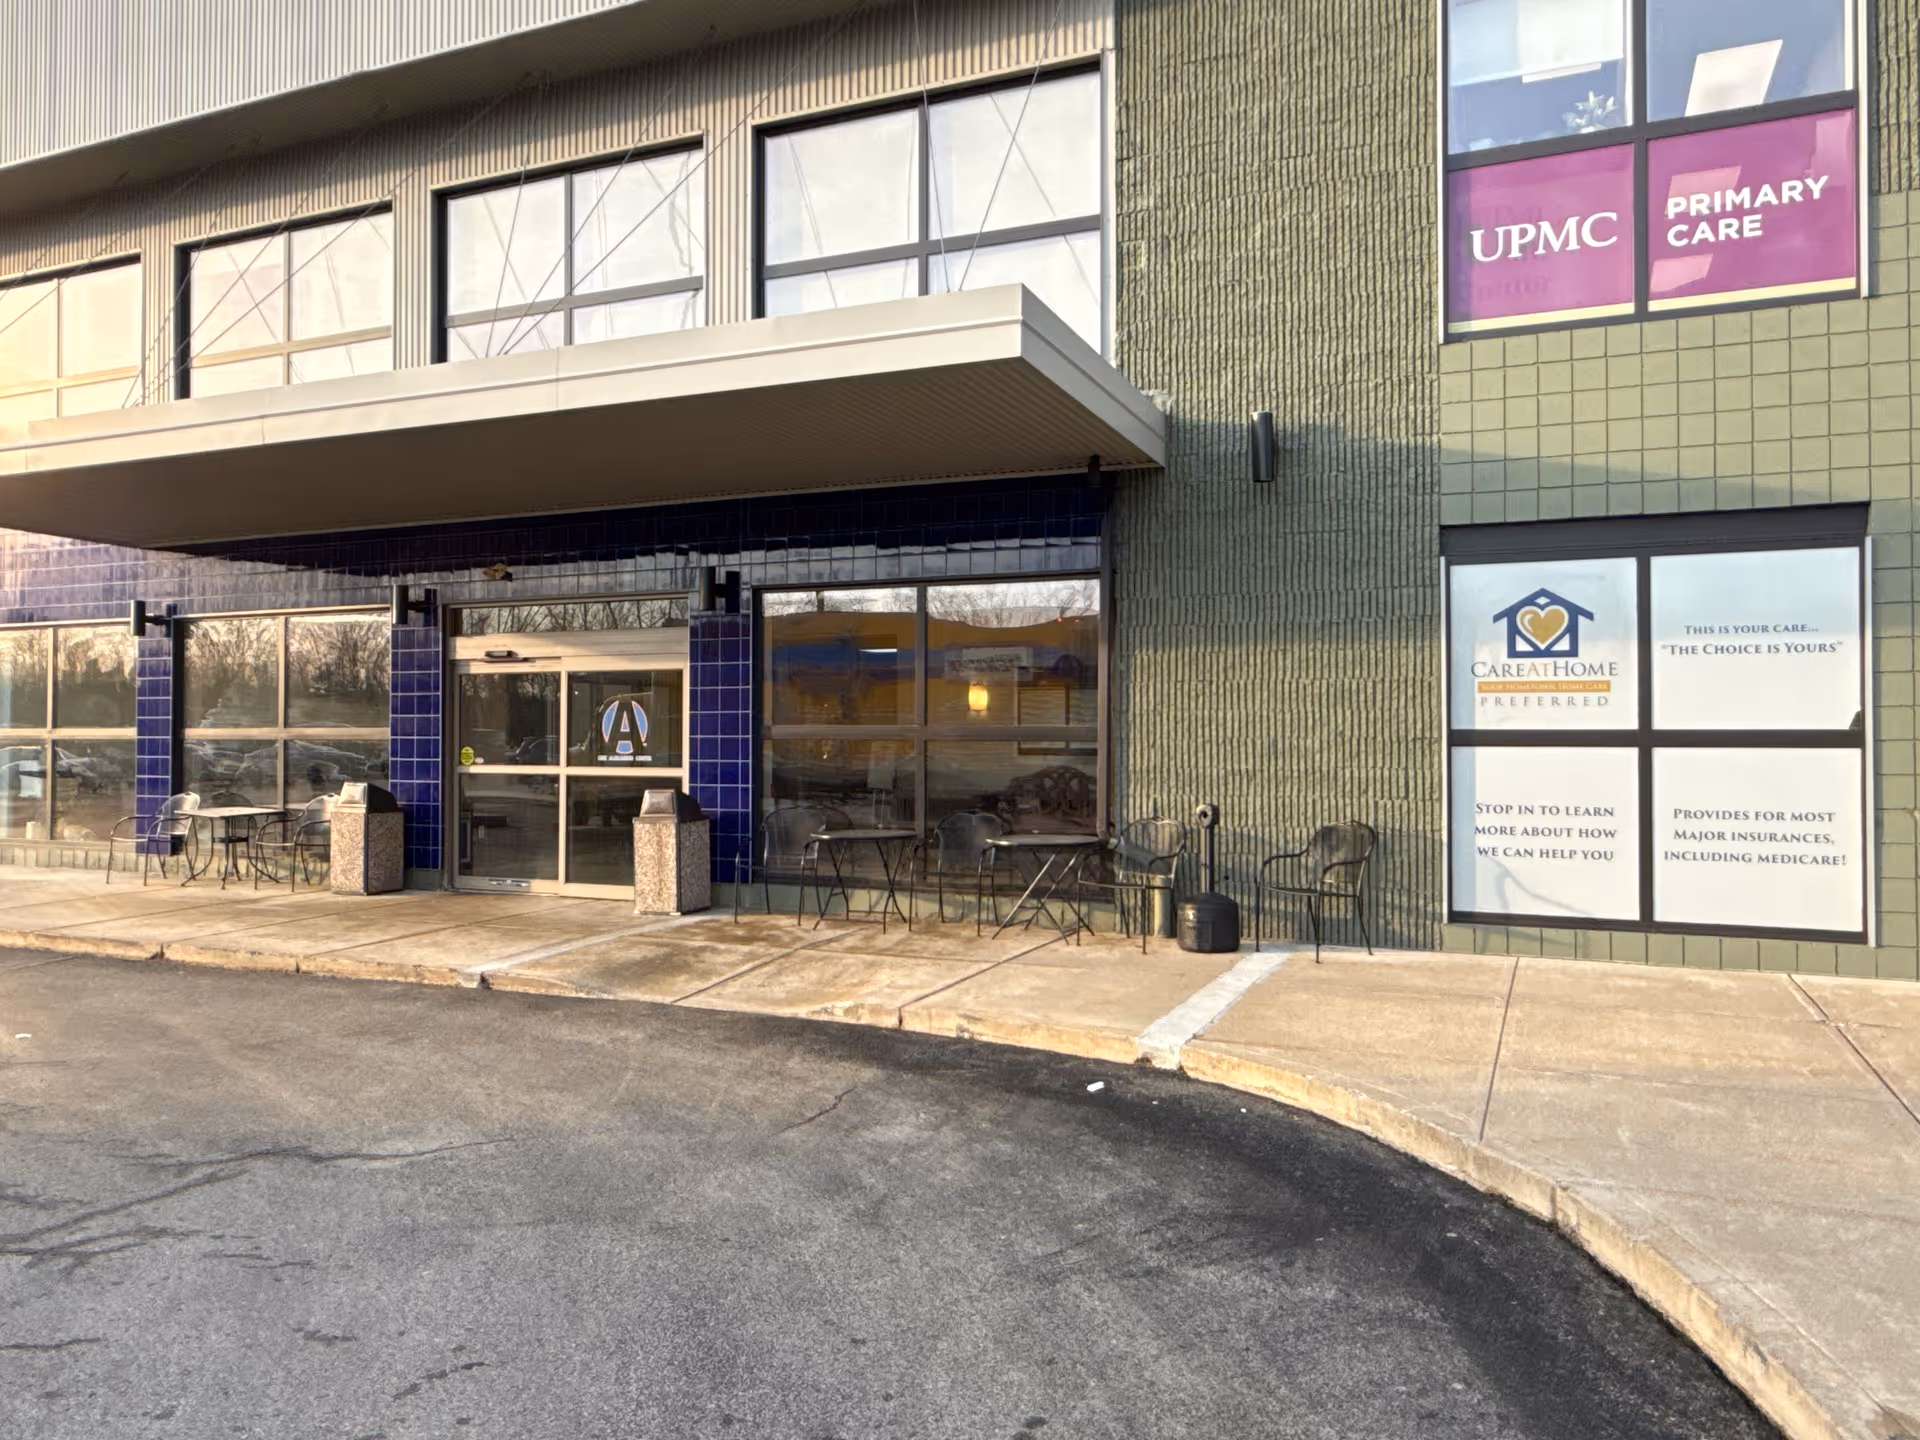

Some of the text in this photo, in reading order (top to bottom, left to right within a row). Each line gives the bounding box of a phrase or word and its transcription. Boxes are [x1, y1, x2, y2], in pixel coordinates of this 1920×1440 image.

[1666, 175, 1829, 219] PRIMARY
[1470, 212, 1618, 262] UPMC
[1667, 214, 1763, 247] CARE
[1684, 625, 1715, 635] THIS
[1718, 625, 1730, 634] IS
[1733, 624, 1769, 634] YOUR
[1702, 643, 1762, 655] CHOICE
[1767, 644, 1780, 654] IS
[1480, 695, 1609, 707] PREFERRED
[1476, 802, 1615, 817] STOP IN TO LEARN
[1673, 808, 1836, 823] PROVIDES FOR MOST
[1474, 825, 1617, 839] MORE ABOUT HOW
[1673, 829, 1836, 845] MAJOR INSURANCES,
[1477, 846, 1615, 861] WE CAN HELP YOU
[1664, 850, 1847, 866] INCLUDING MEDICARE!
